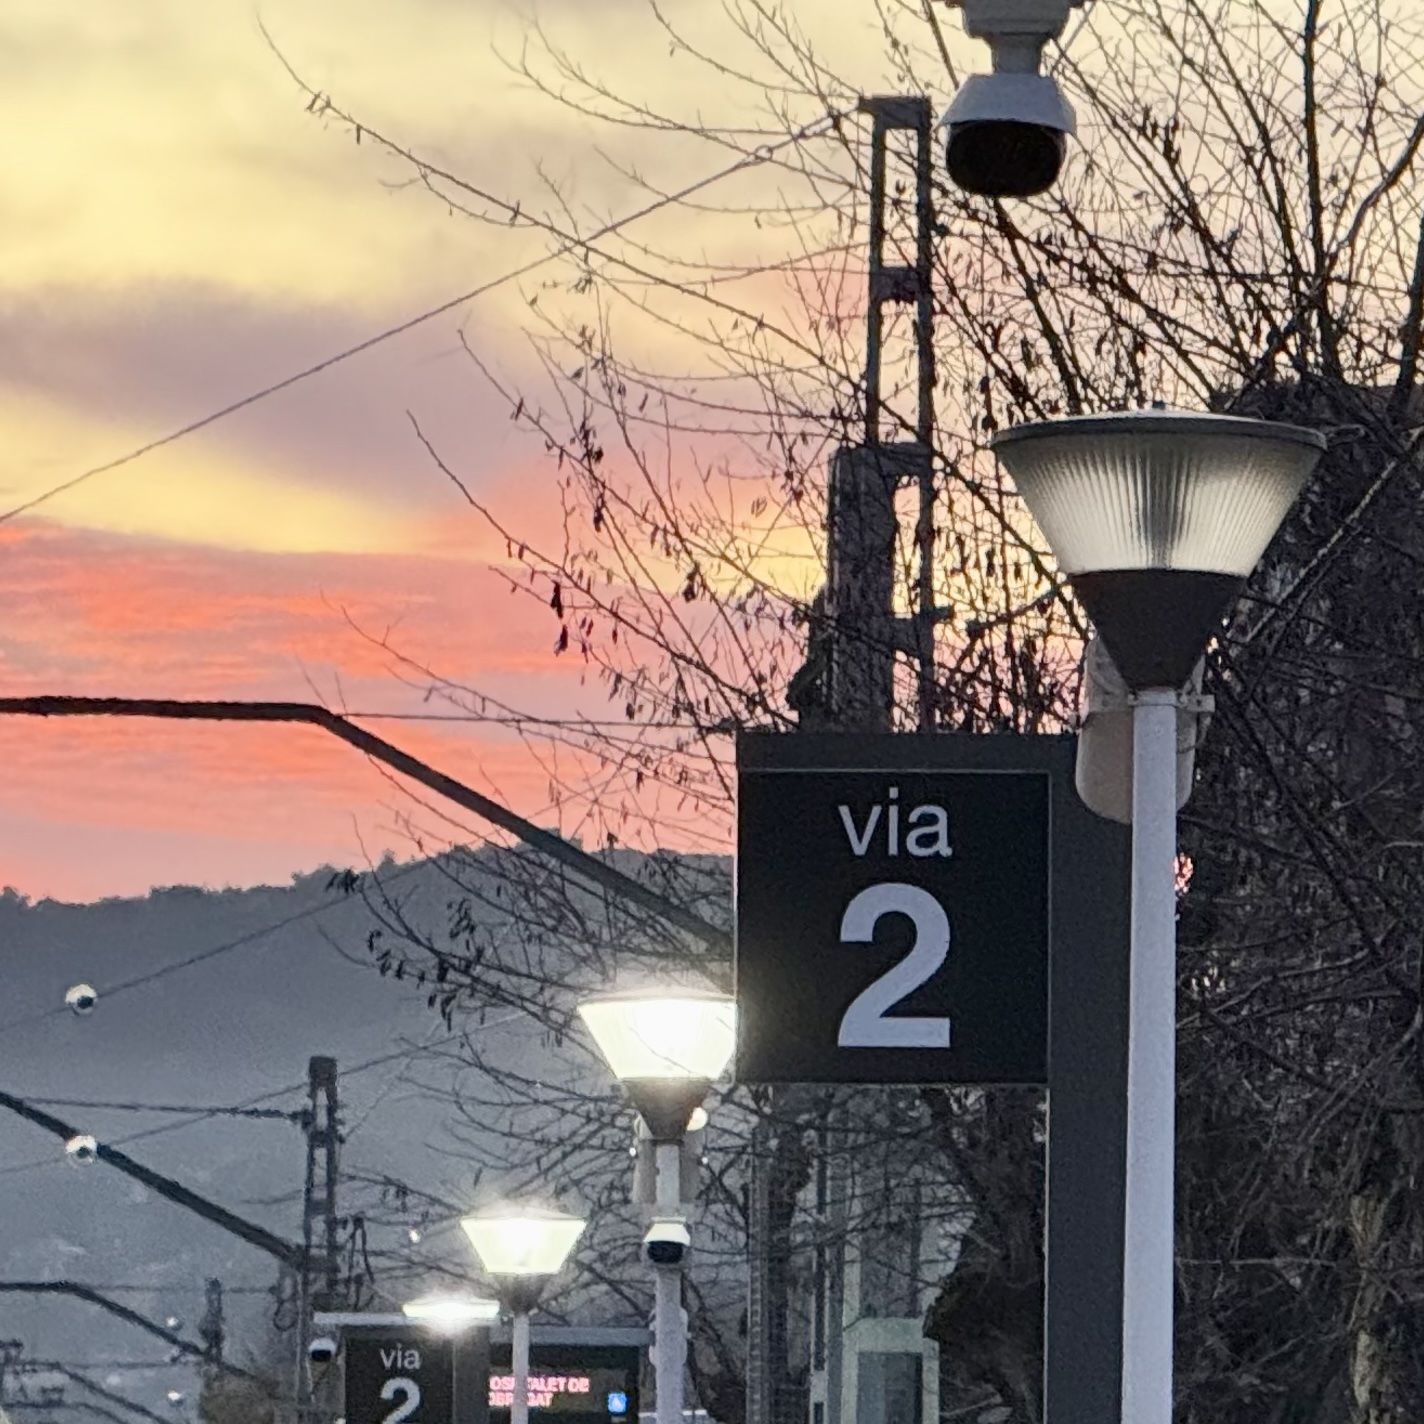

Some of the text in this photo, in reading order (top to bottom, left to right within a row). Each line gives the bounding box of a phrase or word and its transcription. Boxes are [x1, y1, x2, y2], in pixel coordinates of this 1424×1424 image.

[838, 787, 953, 858] via
[837, 883, 951, 1048] 2
[379, 1343, 421, 1370] via
